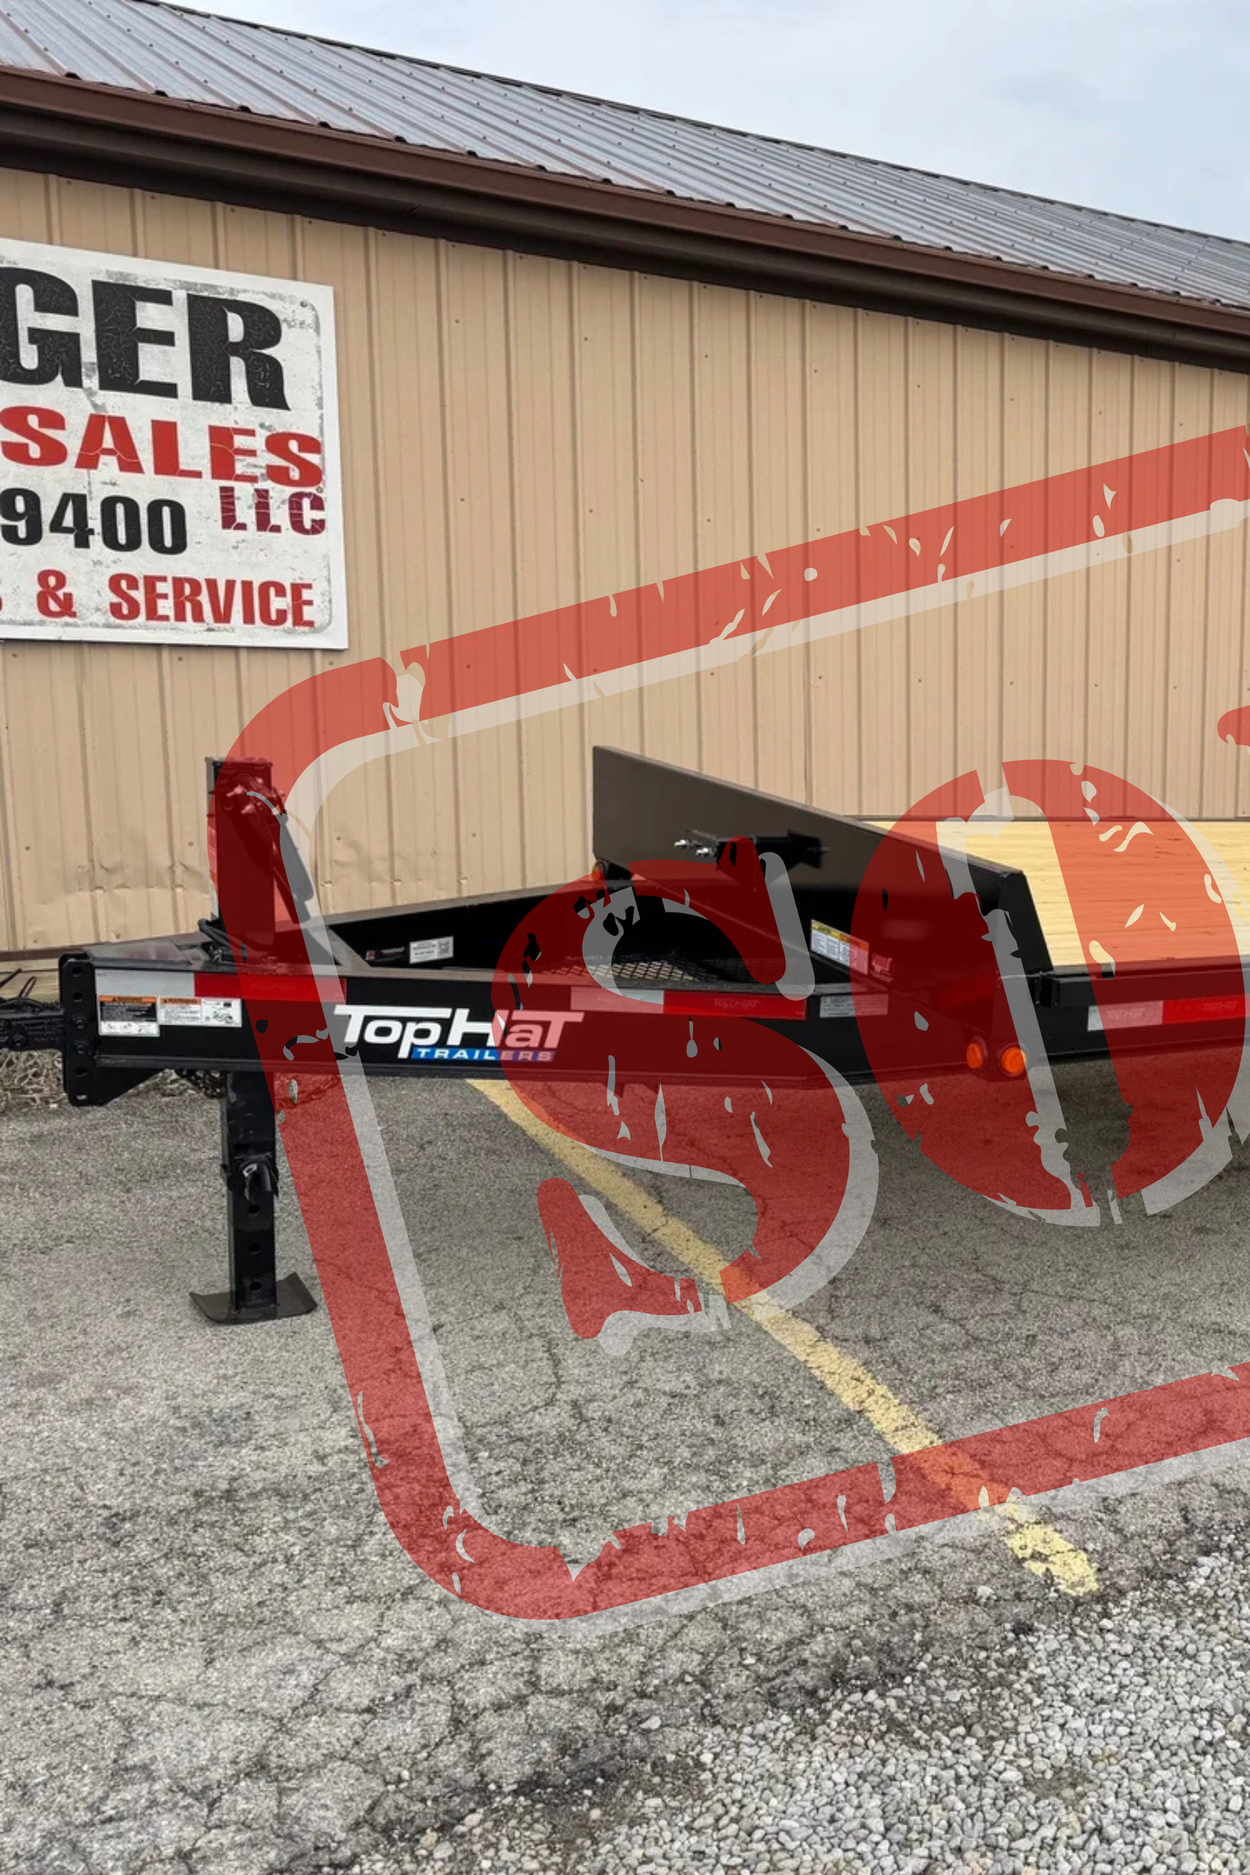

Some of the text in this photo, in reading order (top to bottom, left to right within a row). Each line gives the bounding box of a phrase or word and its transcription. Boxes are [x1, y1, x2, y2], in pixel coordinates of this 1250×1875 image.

[0, 266, 291, 411] GER
[0, 406, 323, 488] SALES
[1, 488, 188, 556] 9400
[219, 486, 326, 536] LLC
[37, 569, 315, 628] & SERVICE
[416, 1048, 554, 1062] TRAILERS
